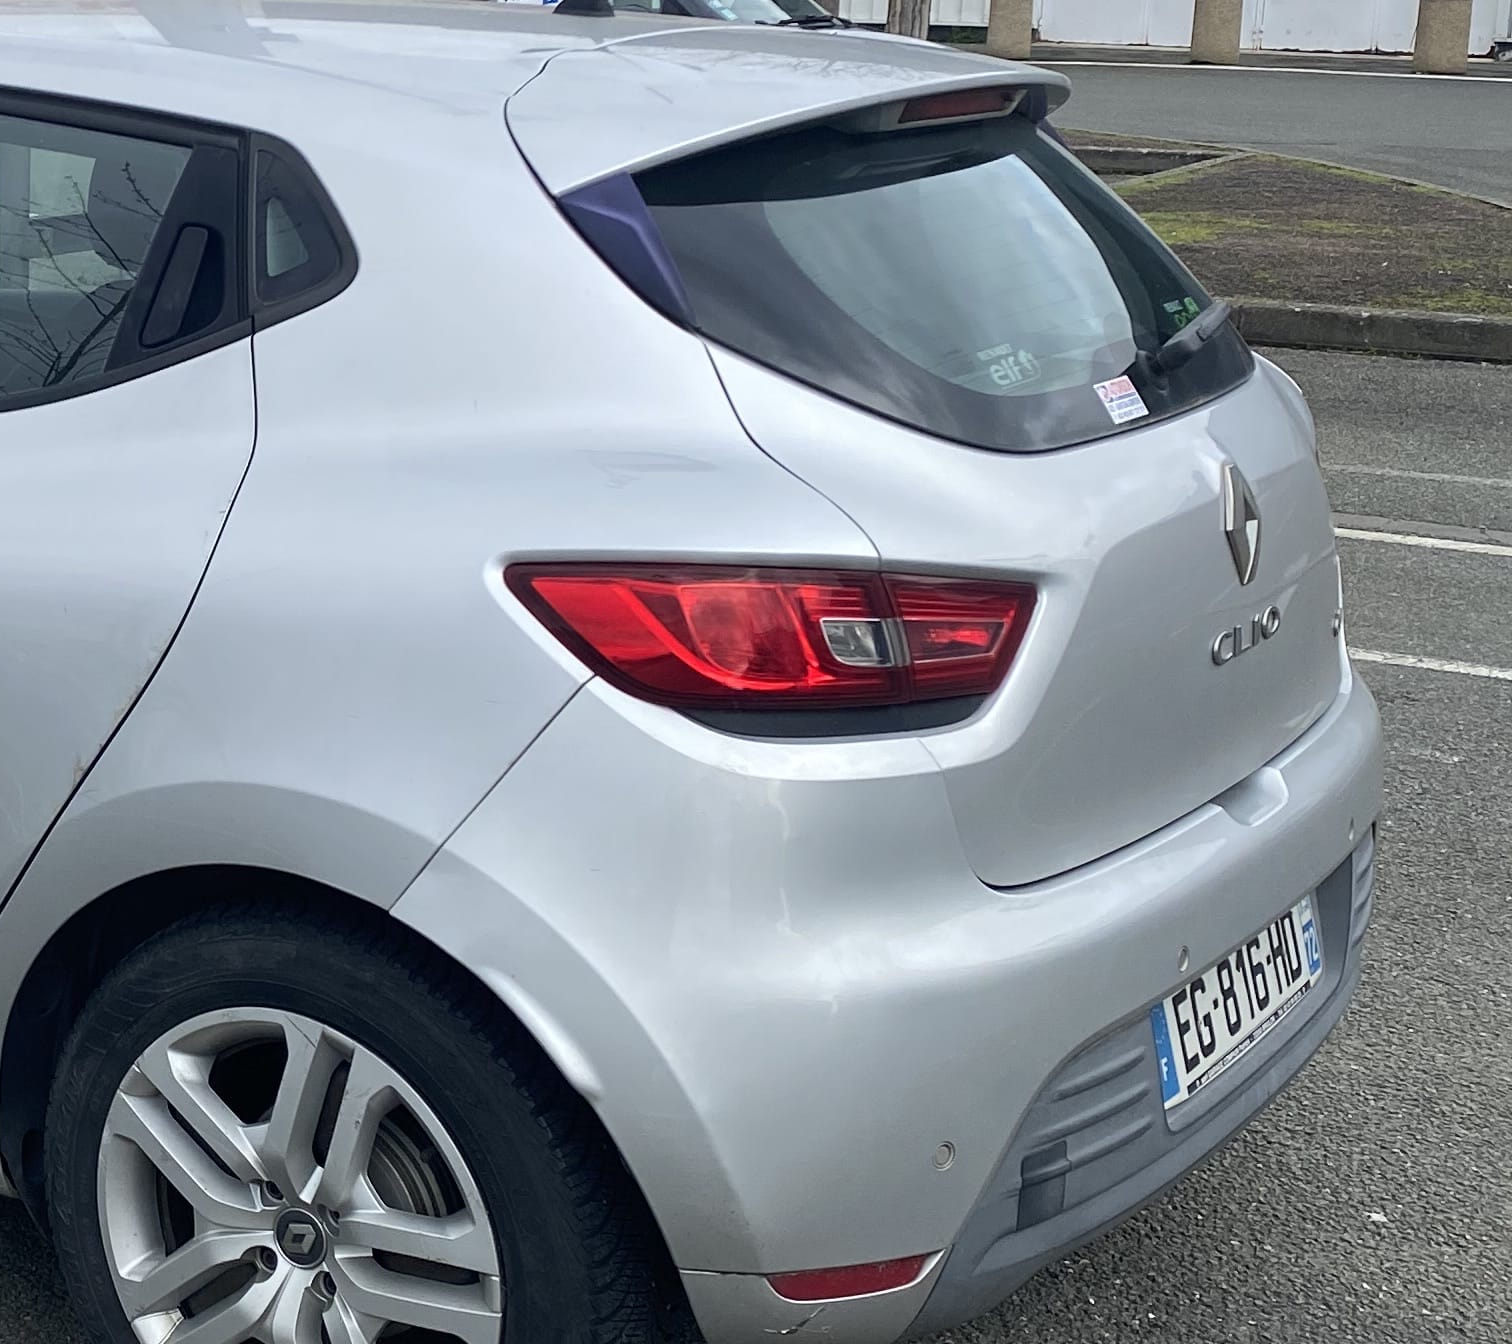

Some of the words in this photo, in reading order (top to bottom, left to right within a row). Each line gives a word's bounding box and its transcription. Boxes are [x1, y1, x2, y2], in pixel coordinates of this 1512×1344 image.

[989, 356, 1024, 385] elf
[1212, 606, 1280, 666] CLIO
[1303, 925, 1319, 966] 72
[1160, 1056, 1168, 1082] F
